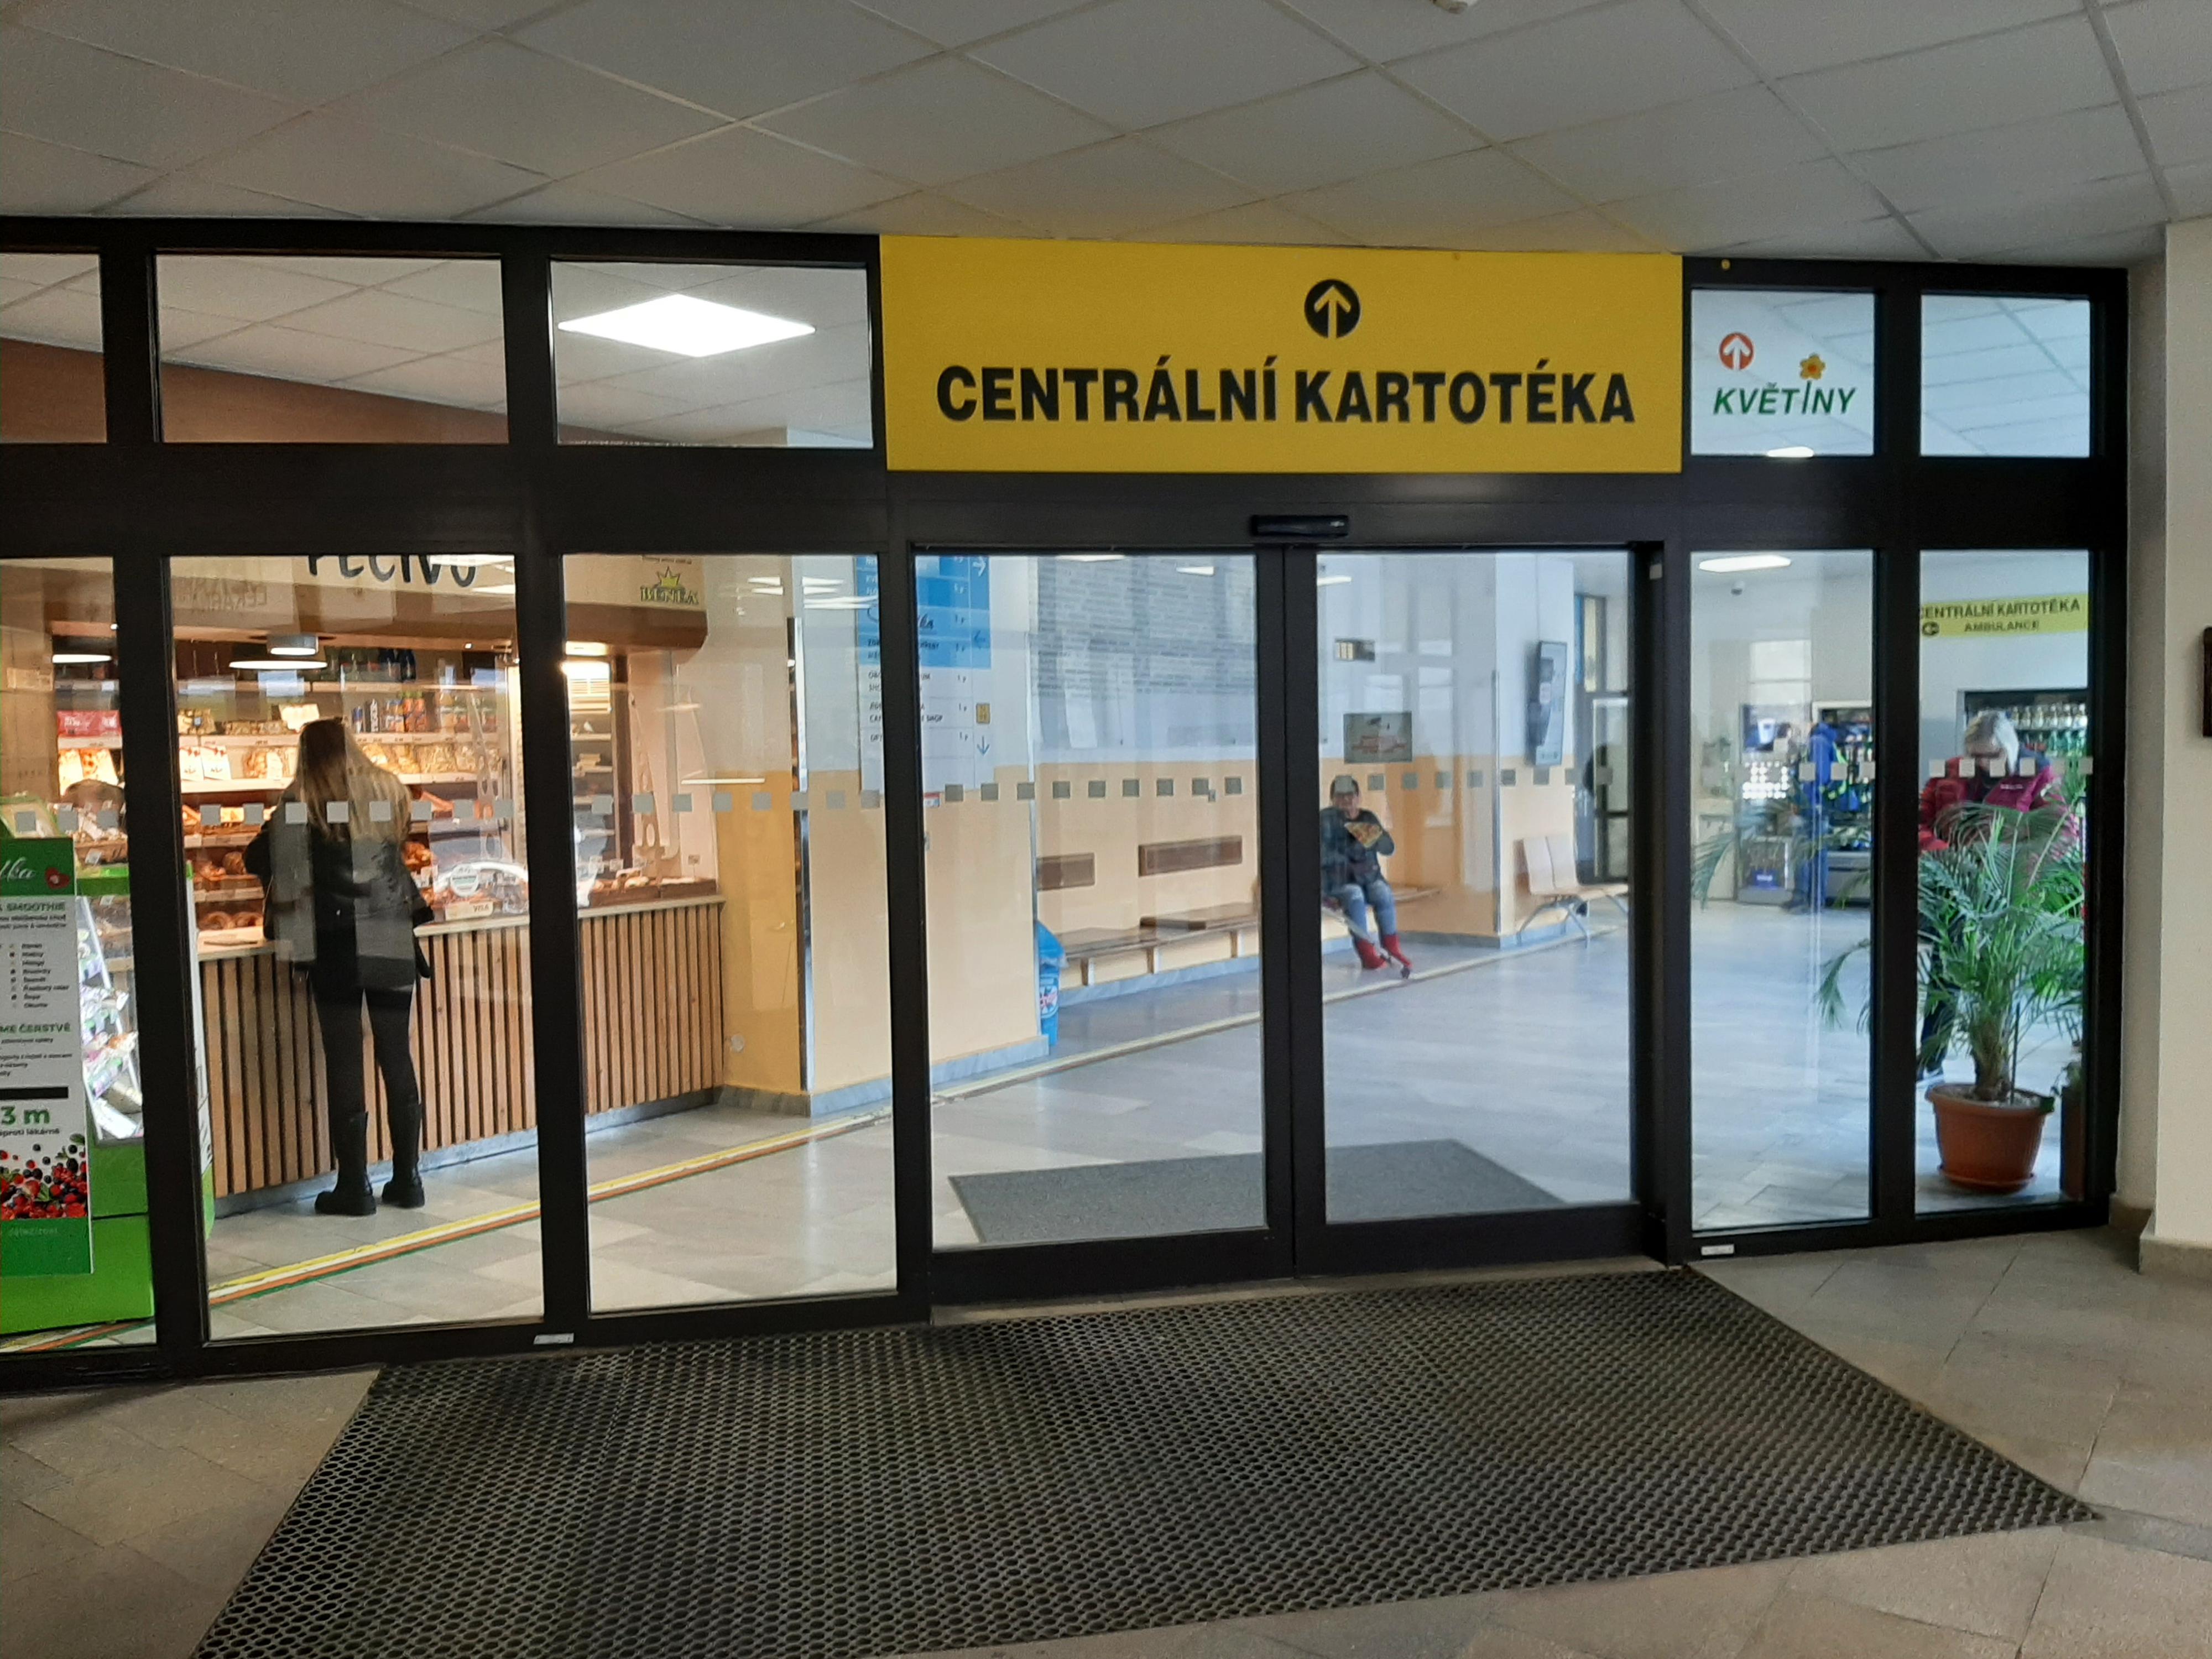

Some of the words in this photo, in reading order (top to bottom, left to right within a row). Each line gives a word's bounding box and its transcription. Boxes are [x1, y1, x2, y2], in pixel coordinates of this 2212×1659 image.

[936, 354, 1277, 422] CENTRÁLNÍ
[1295, 358, 1635, 425] KARTOTÉKA
[1713, 382, 1856, 415] KVĚTINY
[1921, 603, 1994, 619] ENTRÁLNÍ
[1997, 597, 2080, 617] KARTOTÉKA
[1964, 619, 2039, 633] AMBULANCE
[24, 1109, 50, 1124] m
